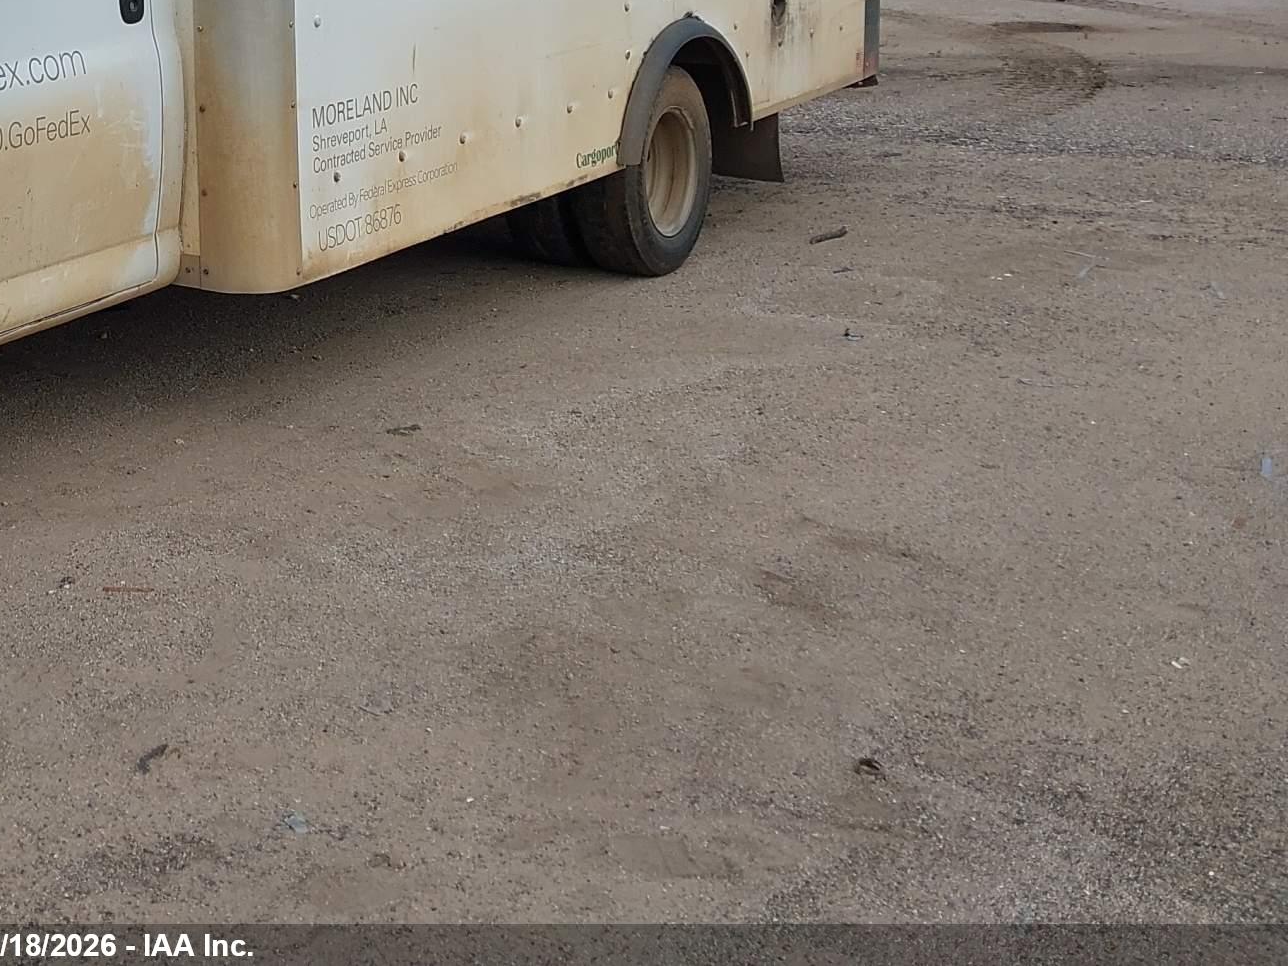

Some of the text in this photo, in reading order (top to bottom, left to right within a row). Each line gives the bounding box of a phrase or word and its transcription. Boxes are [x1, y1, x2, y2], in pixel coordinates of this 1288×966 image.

[312, 83, 418, 129] MORELAND INC
[312, 118, 388, 152] Shreveport, LA
[313, 125, 442, 173] Contracted Service Provider
[309, 162, 458, 220] Operated By Federal Express Corporation
[318, 204, 402, 252] USDOT 86876
